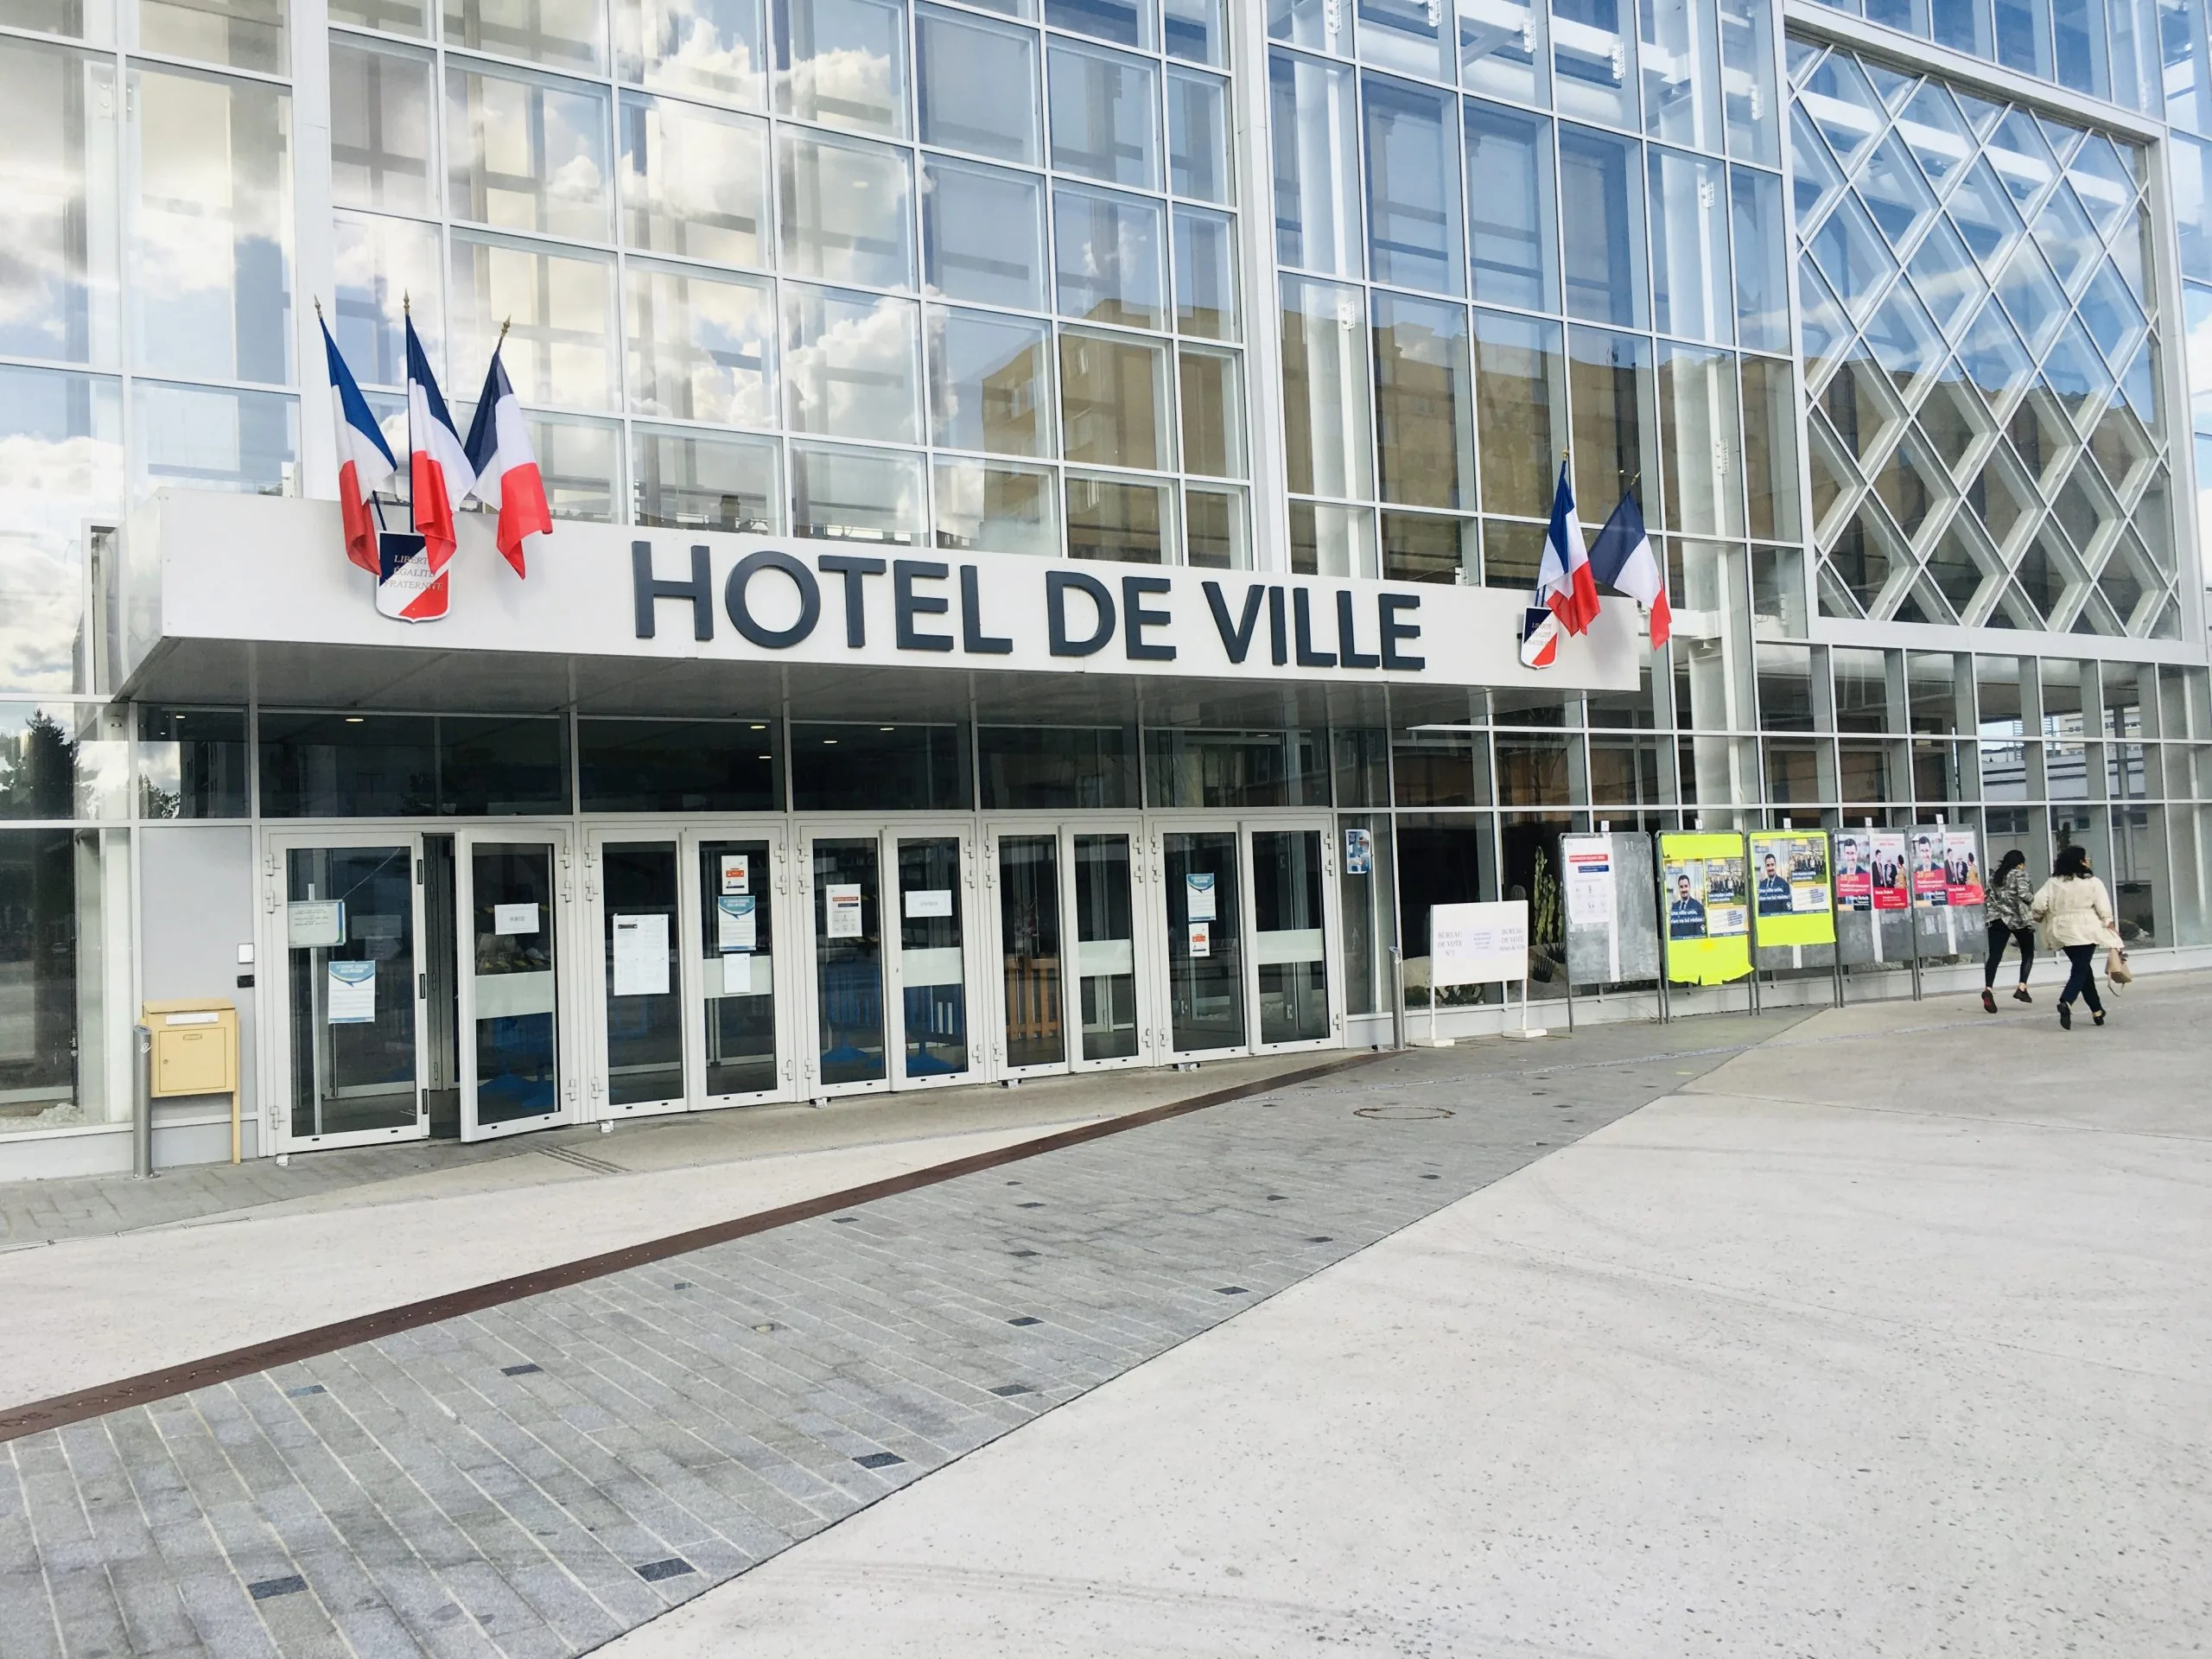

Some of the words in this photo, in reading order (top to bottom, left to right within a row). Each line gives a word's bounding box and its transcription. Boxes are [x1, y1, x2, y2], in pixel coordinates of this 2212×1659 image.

[394, 555, 428, 564] LIBERT
[632, 540, 1013, 654] HOTEL
[1046, 570, 1177, 661] DE
[1202, 581, 1425, 671] VILLE
